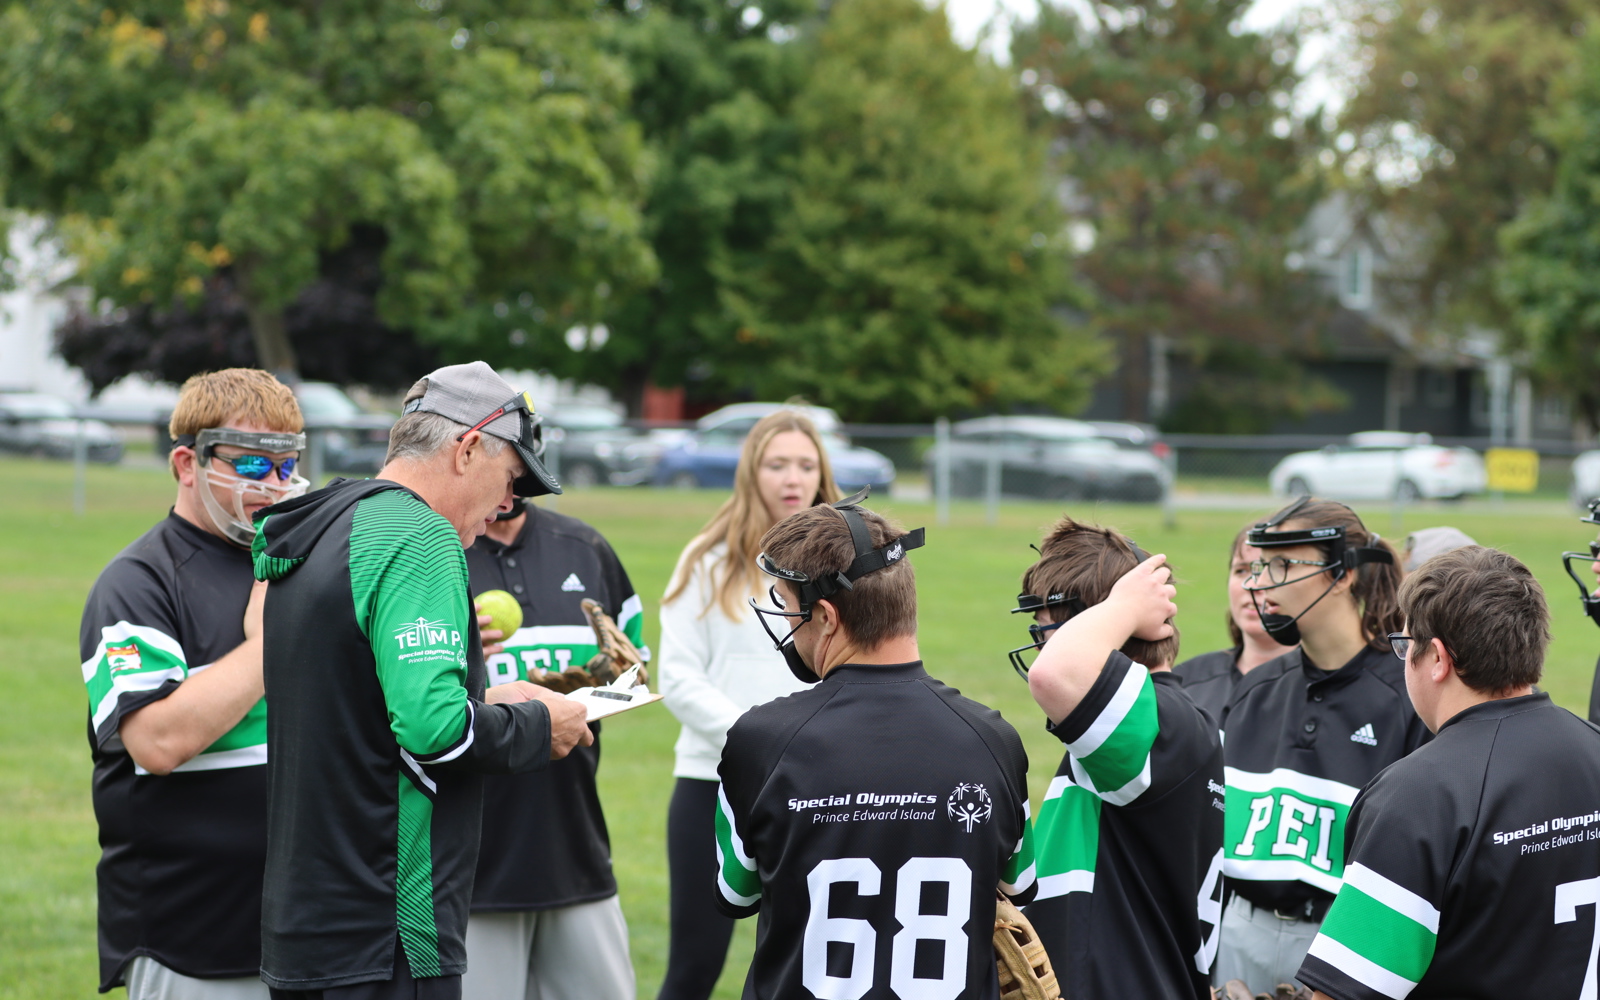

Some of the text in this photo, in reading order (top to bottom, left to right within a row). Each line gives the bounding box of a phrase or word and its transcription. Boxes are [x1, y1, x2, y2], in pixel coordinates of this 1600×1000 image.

[398, 650, 424, 660] Special
[788, 792, 938, 812] Special Olympics
[813, 808, 936, 824] Prince Edward Island
[1493, 810, 1600, 845] Special Olympi
[1234, 794, 1336, 872] PEI
[1521, 842, 1550, 855] Prince
[1551, 830, 1584, 848] Edward
[802, 857, 972, 1000] 68
